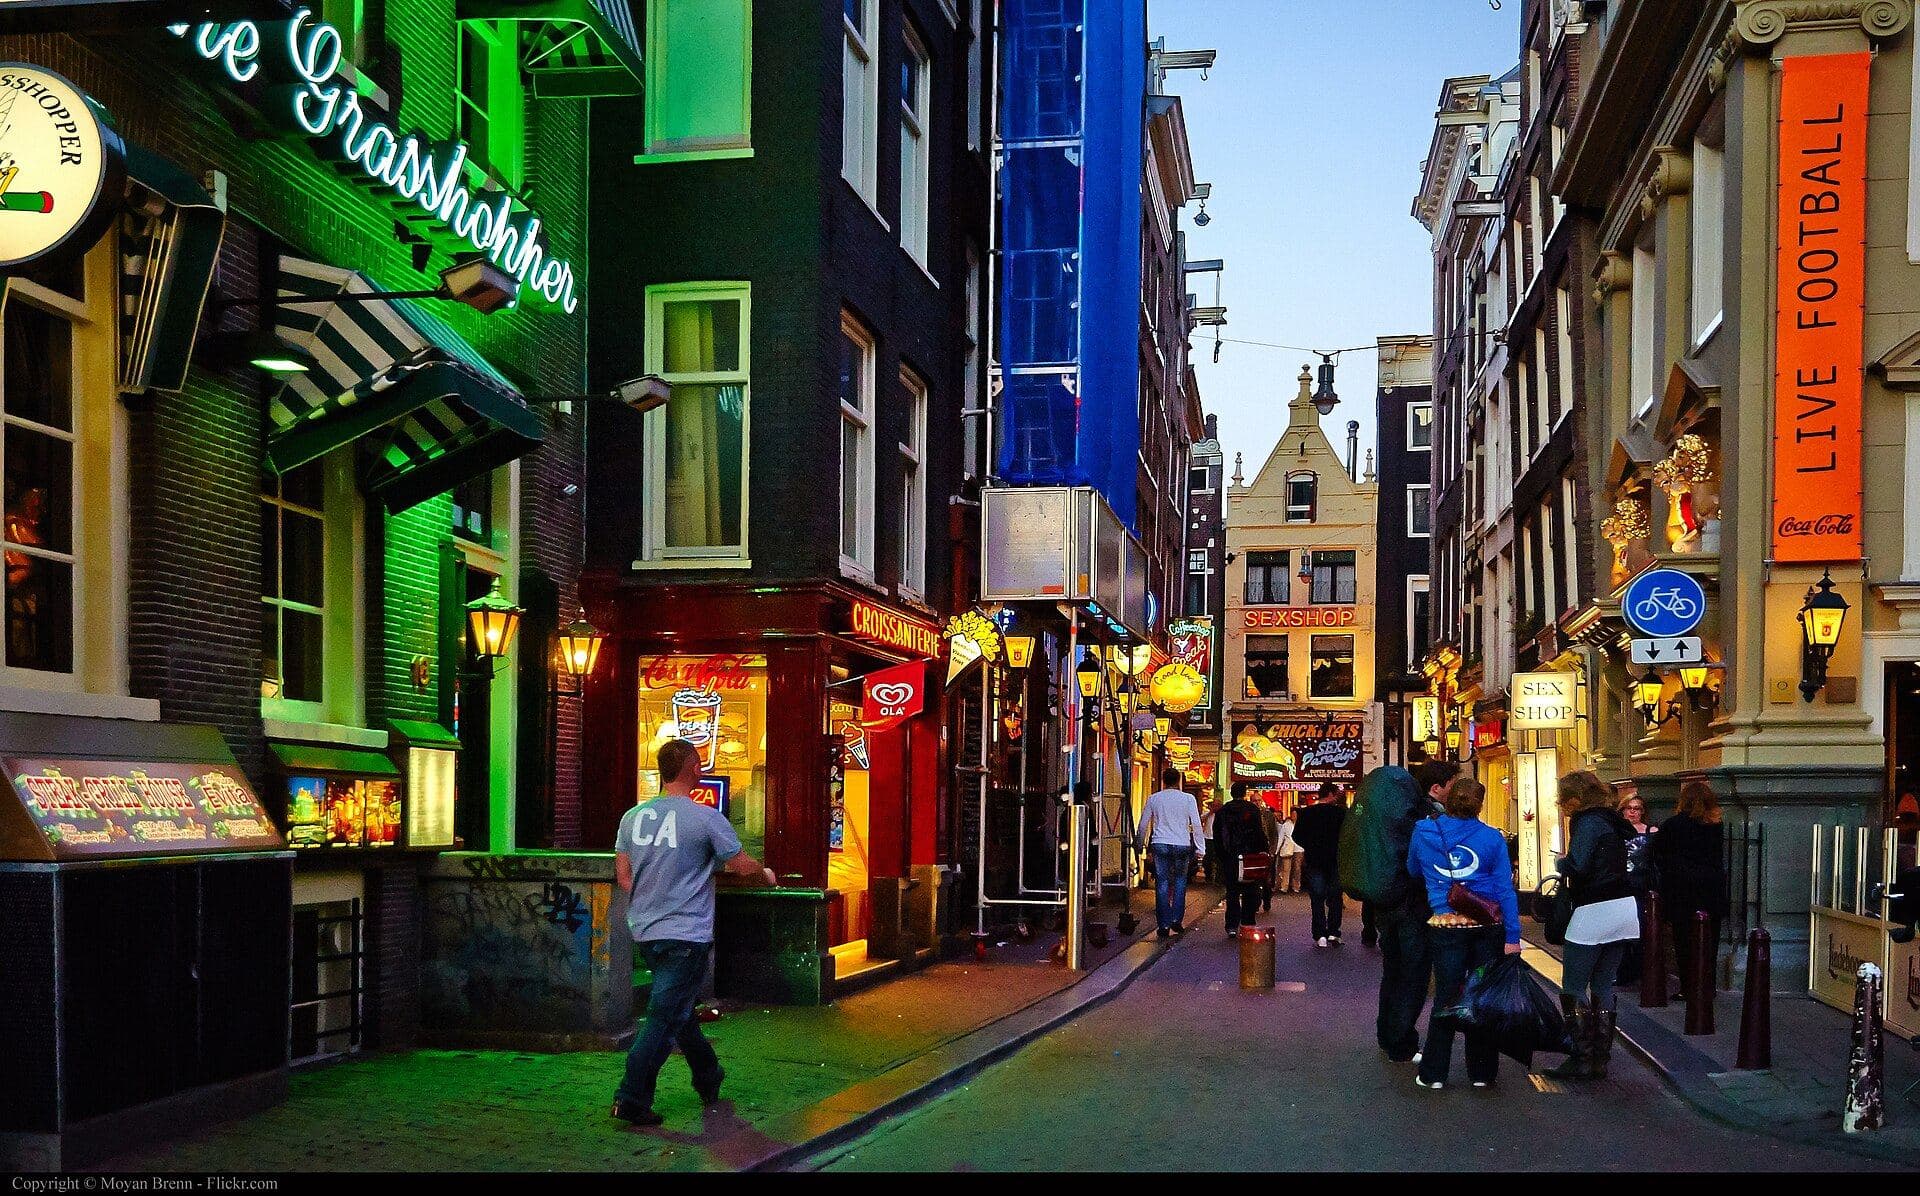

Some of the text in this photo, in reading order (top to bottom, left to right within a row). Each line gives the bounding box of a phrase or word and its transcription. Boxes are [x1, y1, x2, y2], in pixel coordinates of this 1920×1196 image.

[288, 8, 579, 315] Grasshopper
[1796, 103, 1844, 473] LIVE FOOTBALL
[1245, 610, 1353, 628] SEXSHOP
[853, 602, 941, 658] CROISSANTERIE
[1169, 621, 1210, 637] Coffeeshop
[1523, 682, 1564, 695] SEX
[880, 707, 903, 716] OLA
[1514, 706, 1573, 720] SHOP
[1316, 739, 1345, 756] SEX
[631, 808, 677, 849] CA
